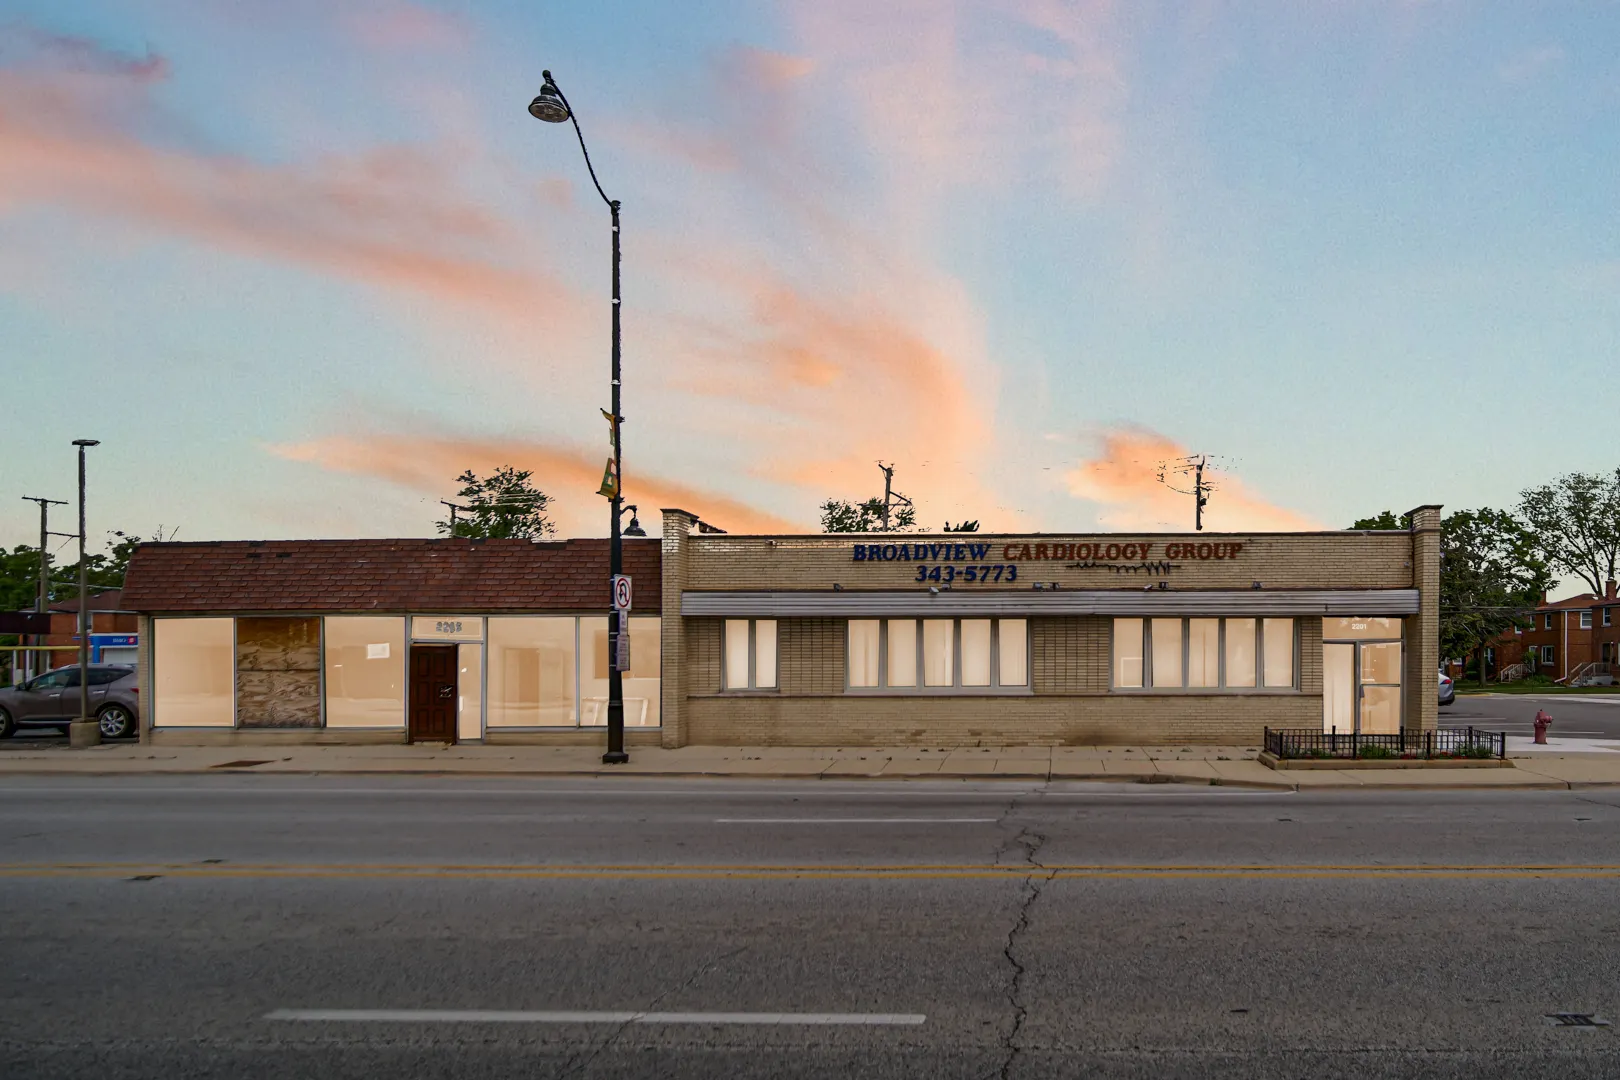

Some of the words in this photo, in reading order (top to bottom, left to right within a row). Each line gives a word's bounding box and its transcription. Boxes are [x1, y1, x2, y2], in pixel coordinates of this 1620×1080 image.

[853, 543, 992, 561] BROADVIEW
[1003, 543, 1153, 560] CARDIOLOGY
[1165, 542, 1243, 560] GROUP
[915, 565, 1017, 582] 343-5773
